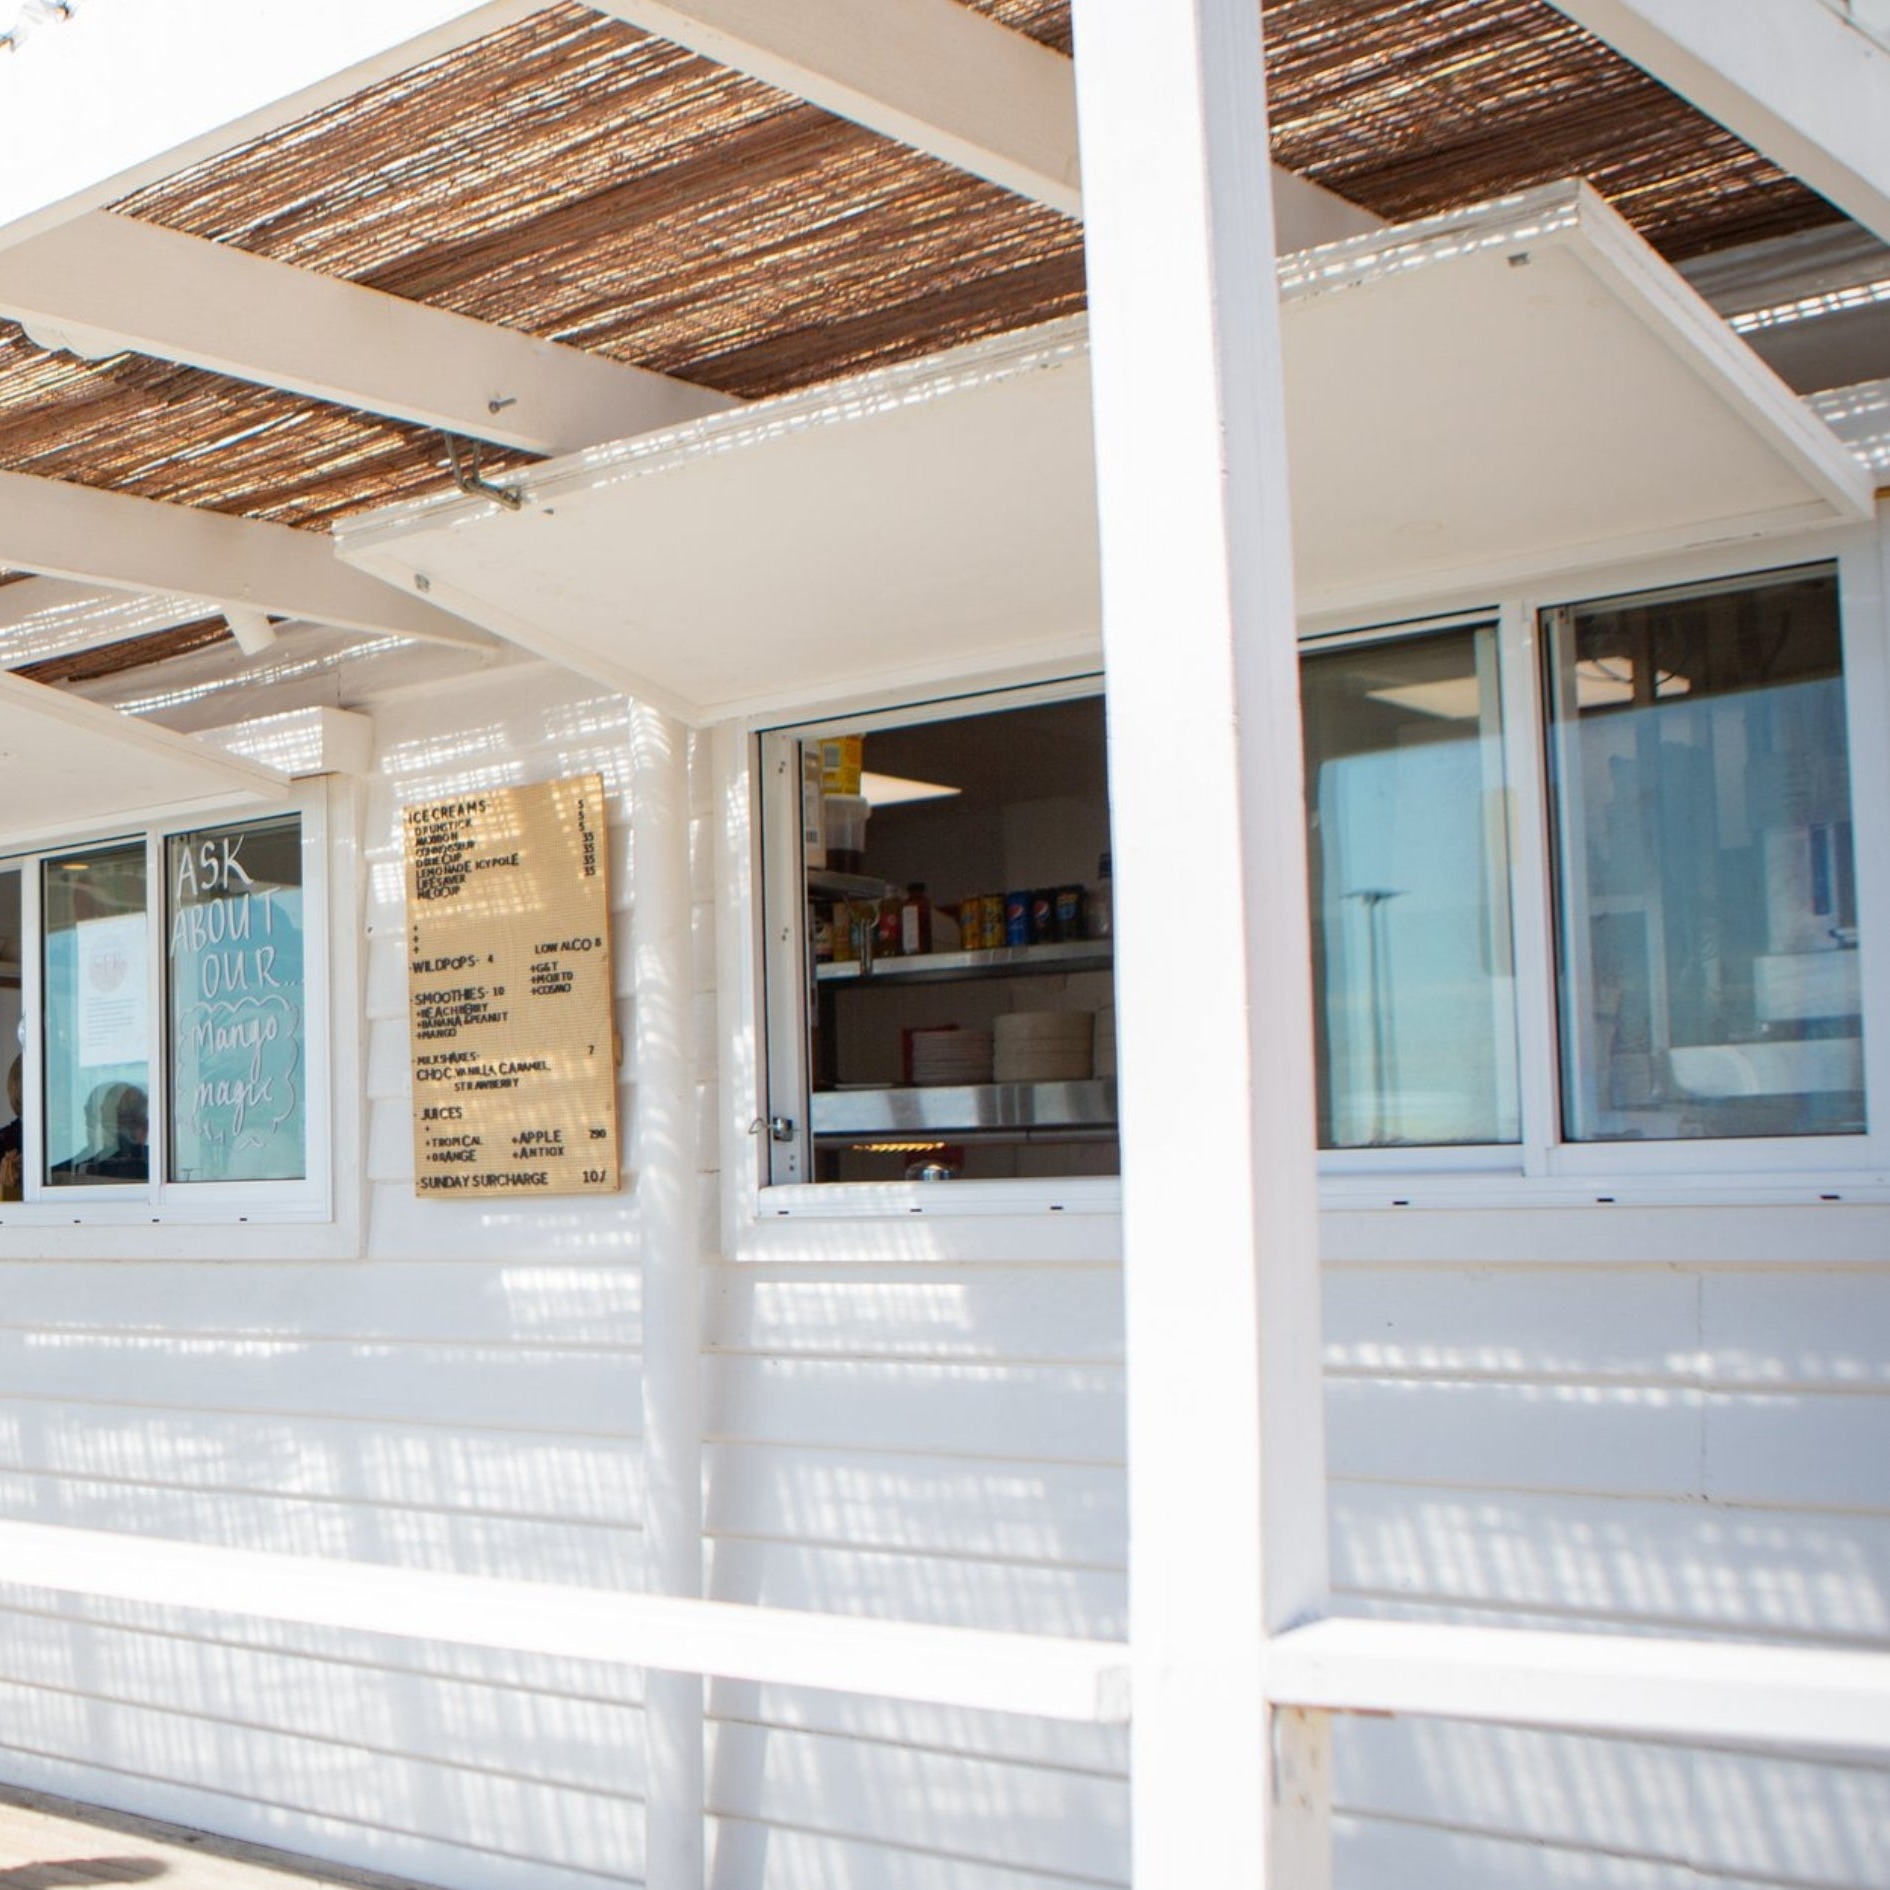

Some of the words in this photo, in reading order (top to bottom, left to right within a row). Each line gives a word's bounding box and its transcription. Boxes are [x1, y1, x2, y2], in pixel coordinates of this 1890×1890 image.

[177, 834, 254, 906] ASK
[416, 860, 472, 879] LEMONADE
[169, 886, 281, 958] ABOUT
[421, 1106, 463, 1120] JUICES
[420, 1176, 470, 1189] SUNDAY
[472, 1172, 549, 1187] SURCHARGE
